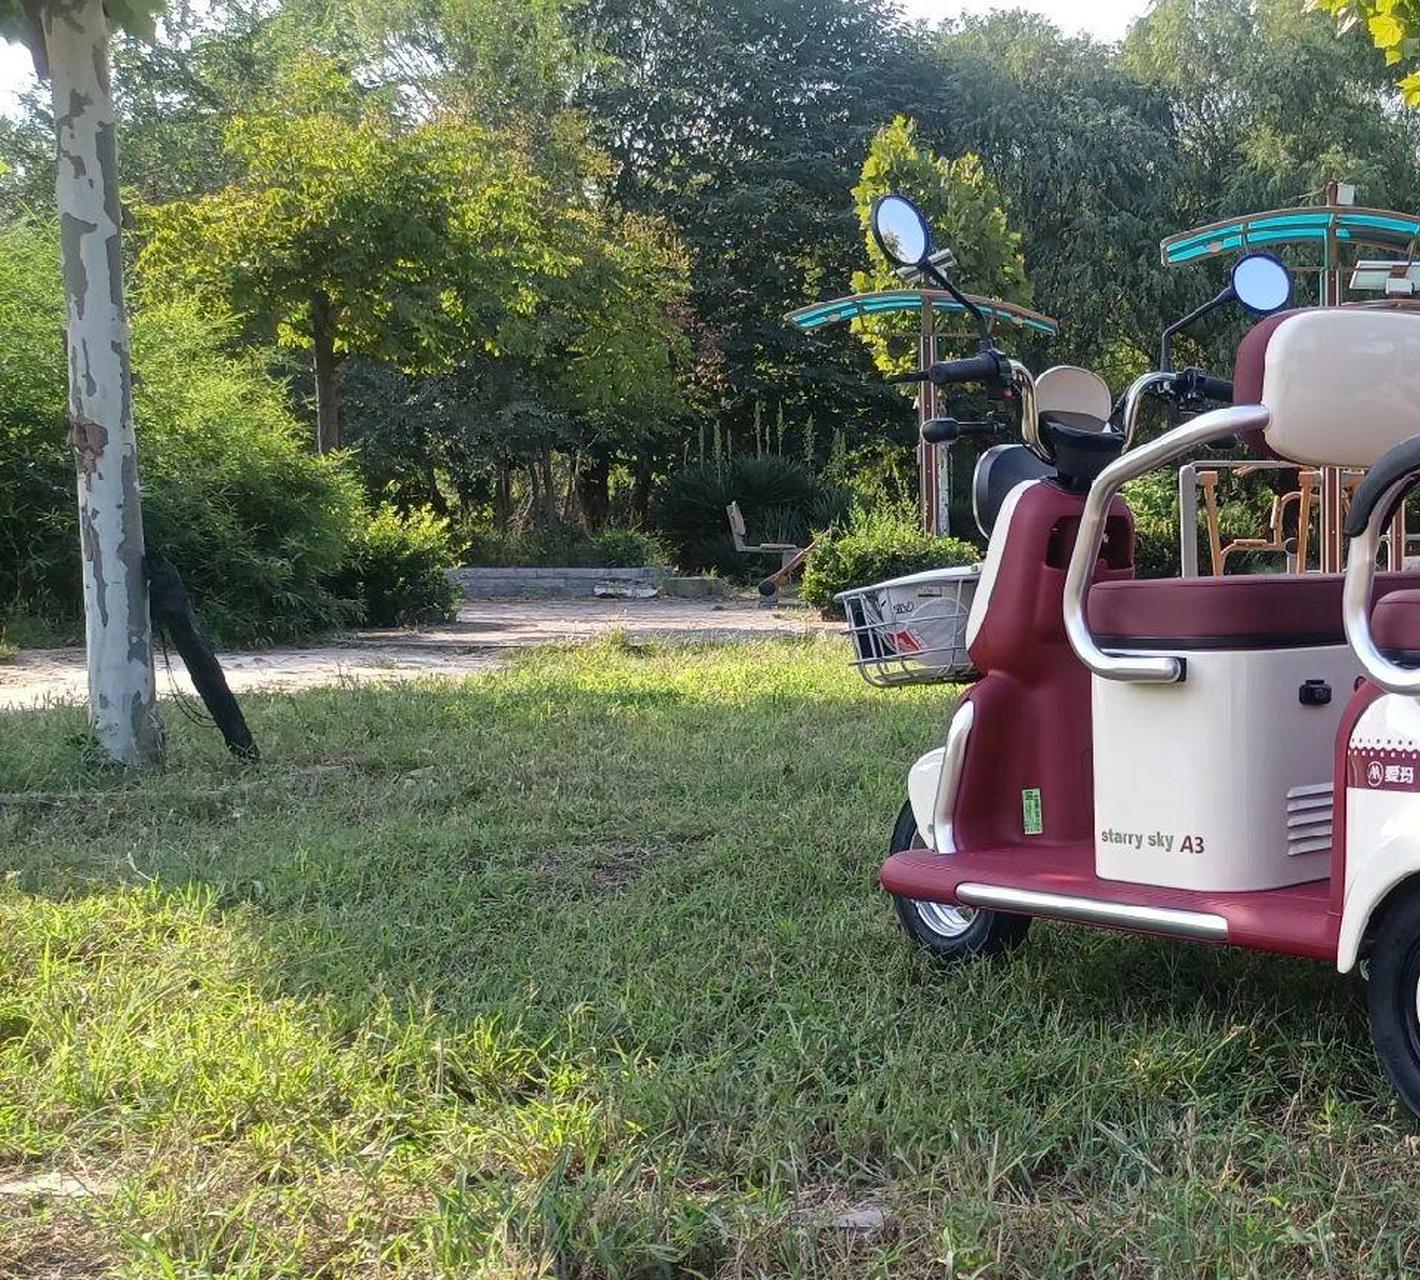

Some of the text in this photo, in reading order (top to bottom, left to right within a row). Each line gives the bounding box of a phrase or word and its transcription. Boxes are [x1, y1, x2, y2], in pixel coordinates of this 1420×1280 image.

[1385, 764, 1414, 784] 爱玛
[1101, 828, 1205, 854] starry sky A3
